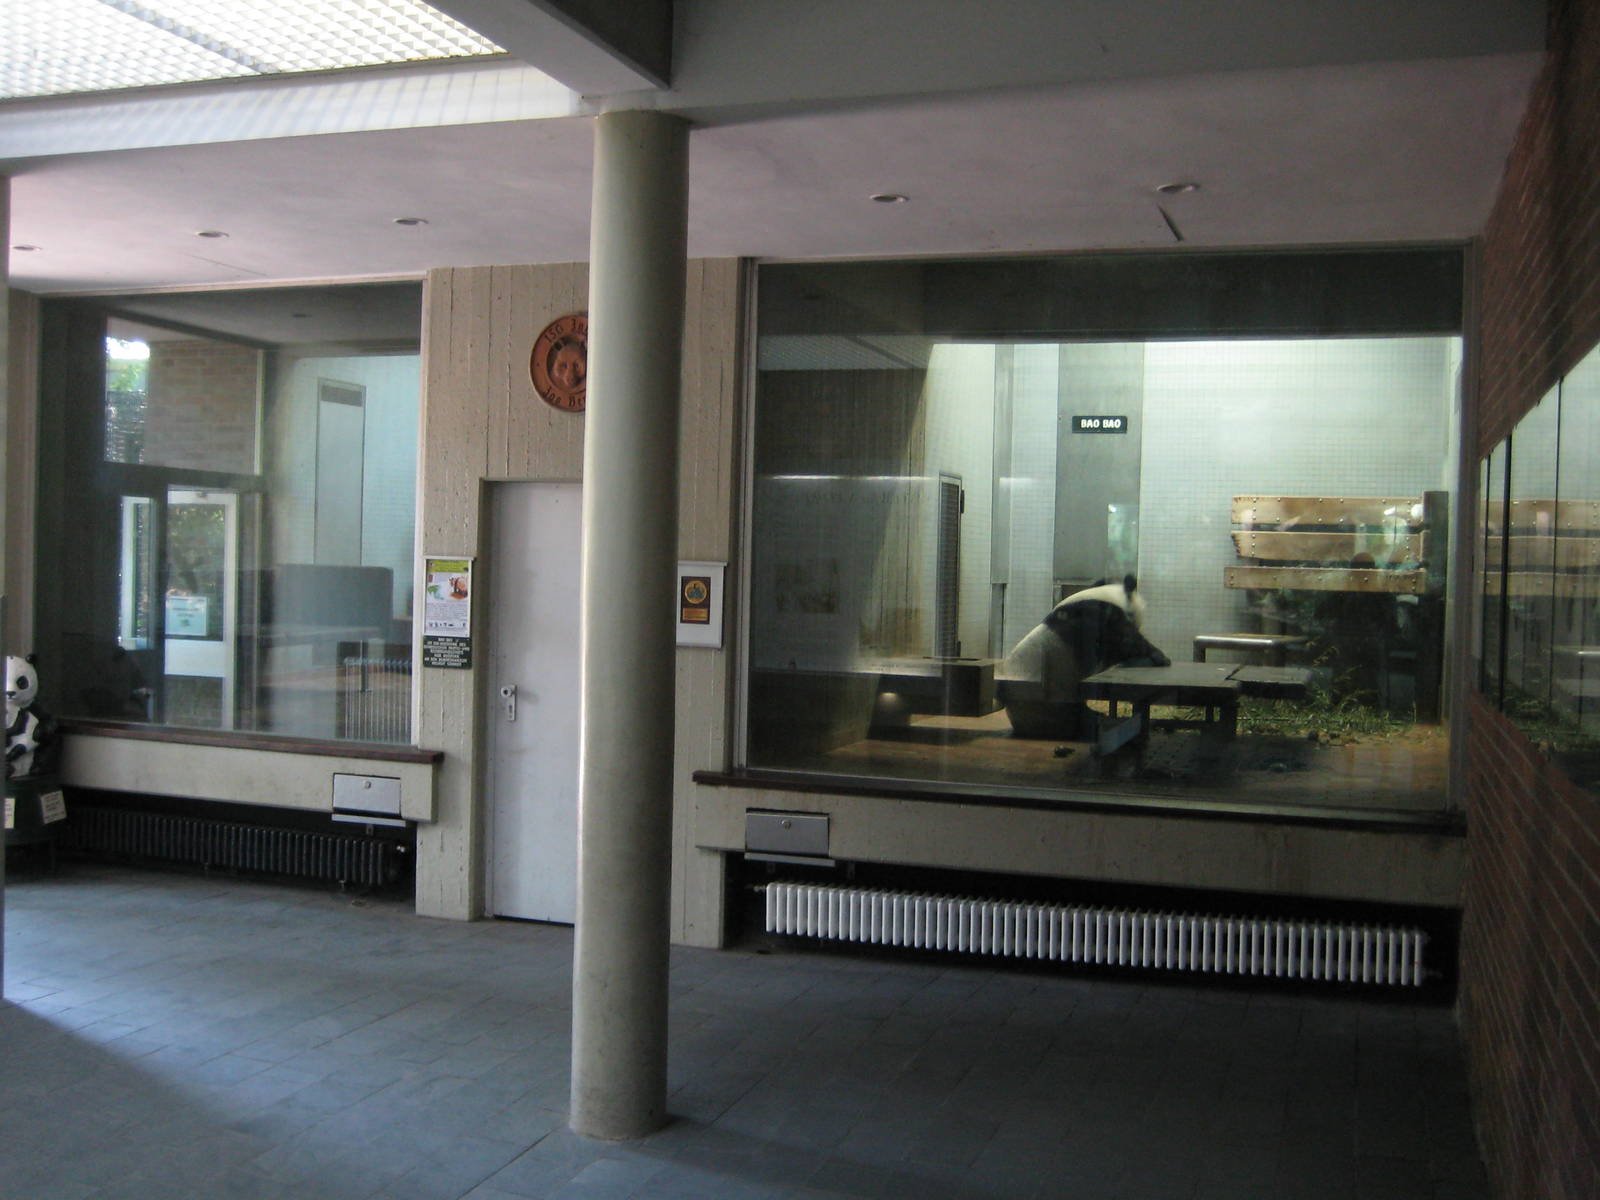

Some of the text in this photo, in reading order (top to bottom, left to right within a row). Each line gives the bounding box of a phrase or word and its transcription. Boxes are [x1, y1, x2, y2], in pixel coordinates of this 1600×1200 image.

[544, 318, 587, 343] 150 Ja
[1080, 419, 1121, 428] BAO BAO
